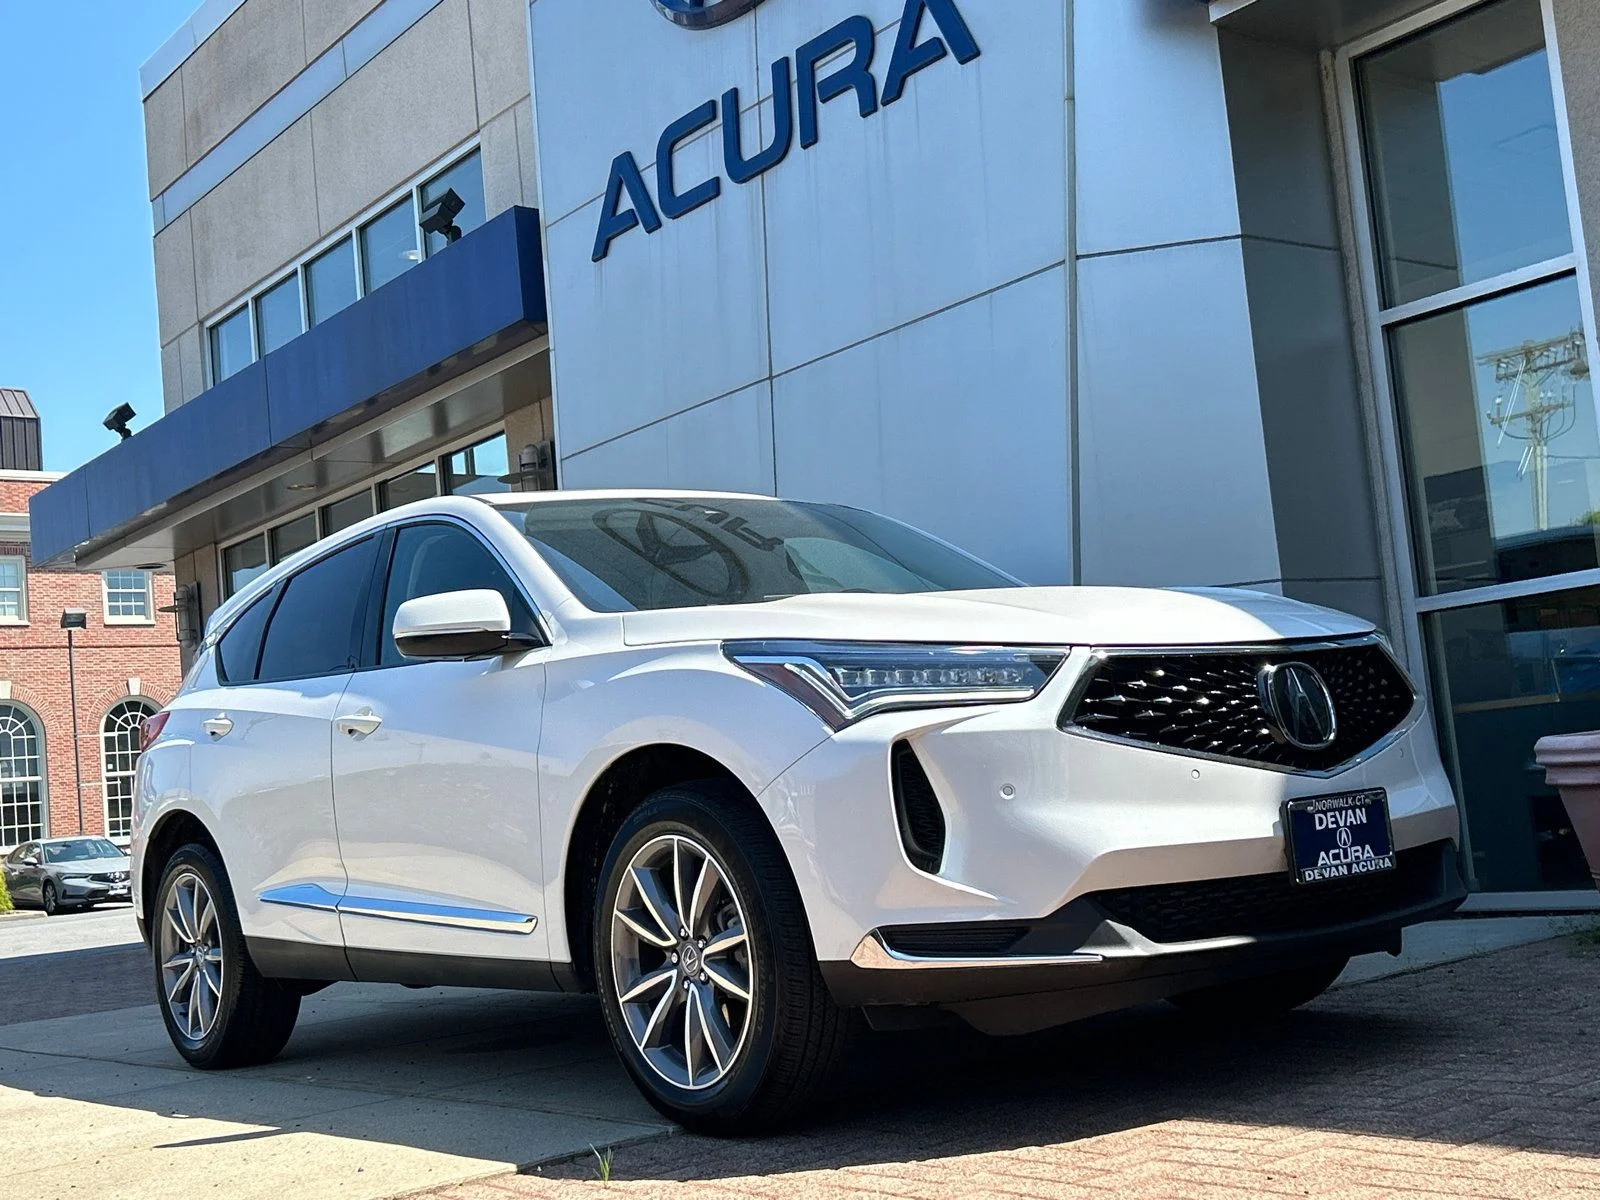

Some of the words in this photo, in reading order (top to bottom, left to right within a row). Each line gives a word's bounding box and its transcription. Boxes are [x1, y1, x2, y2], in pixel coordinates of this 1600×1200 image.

[592, 0, 981, 263] ACURA
[1355, 794, 1366, 806] CT
[1314, 807, 1368, 831] DEVAN
[1317, 844, 1375, 867] ACURA
[1305, 865, 1348, 882] DEVAN
[1351, 857, 1393, 874] ACURA
